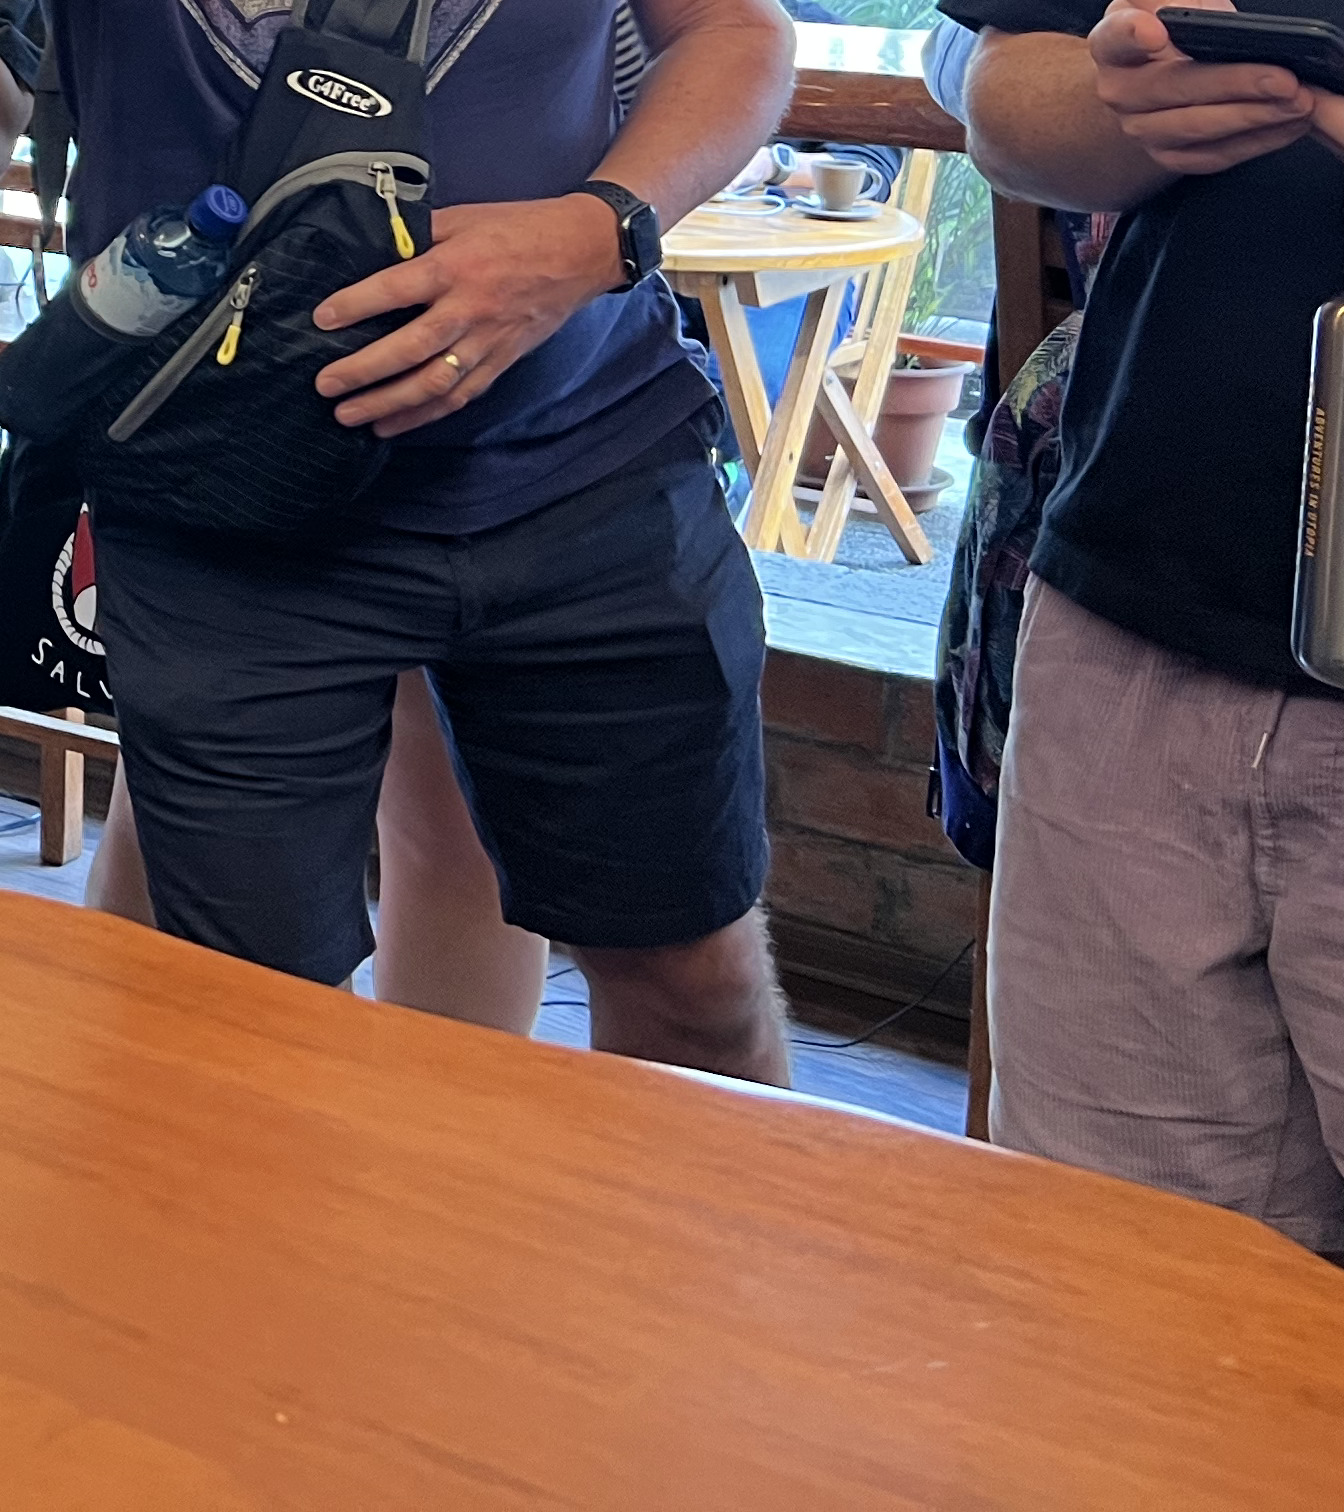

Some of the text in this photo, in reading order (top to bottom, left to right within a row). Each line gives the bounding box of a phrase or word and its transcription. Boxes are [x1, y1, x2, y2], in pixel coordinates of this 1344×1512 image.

[308, 75, 374, 111] G4Free
[1304, 407, 1326, 557] ADVENTURES IN UTOPIA
